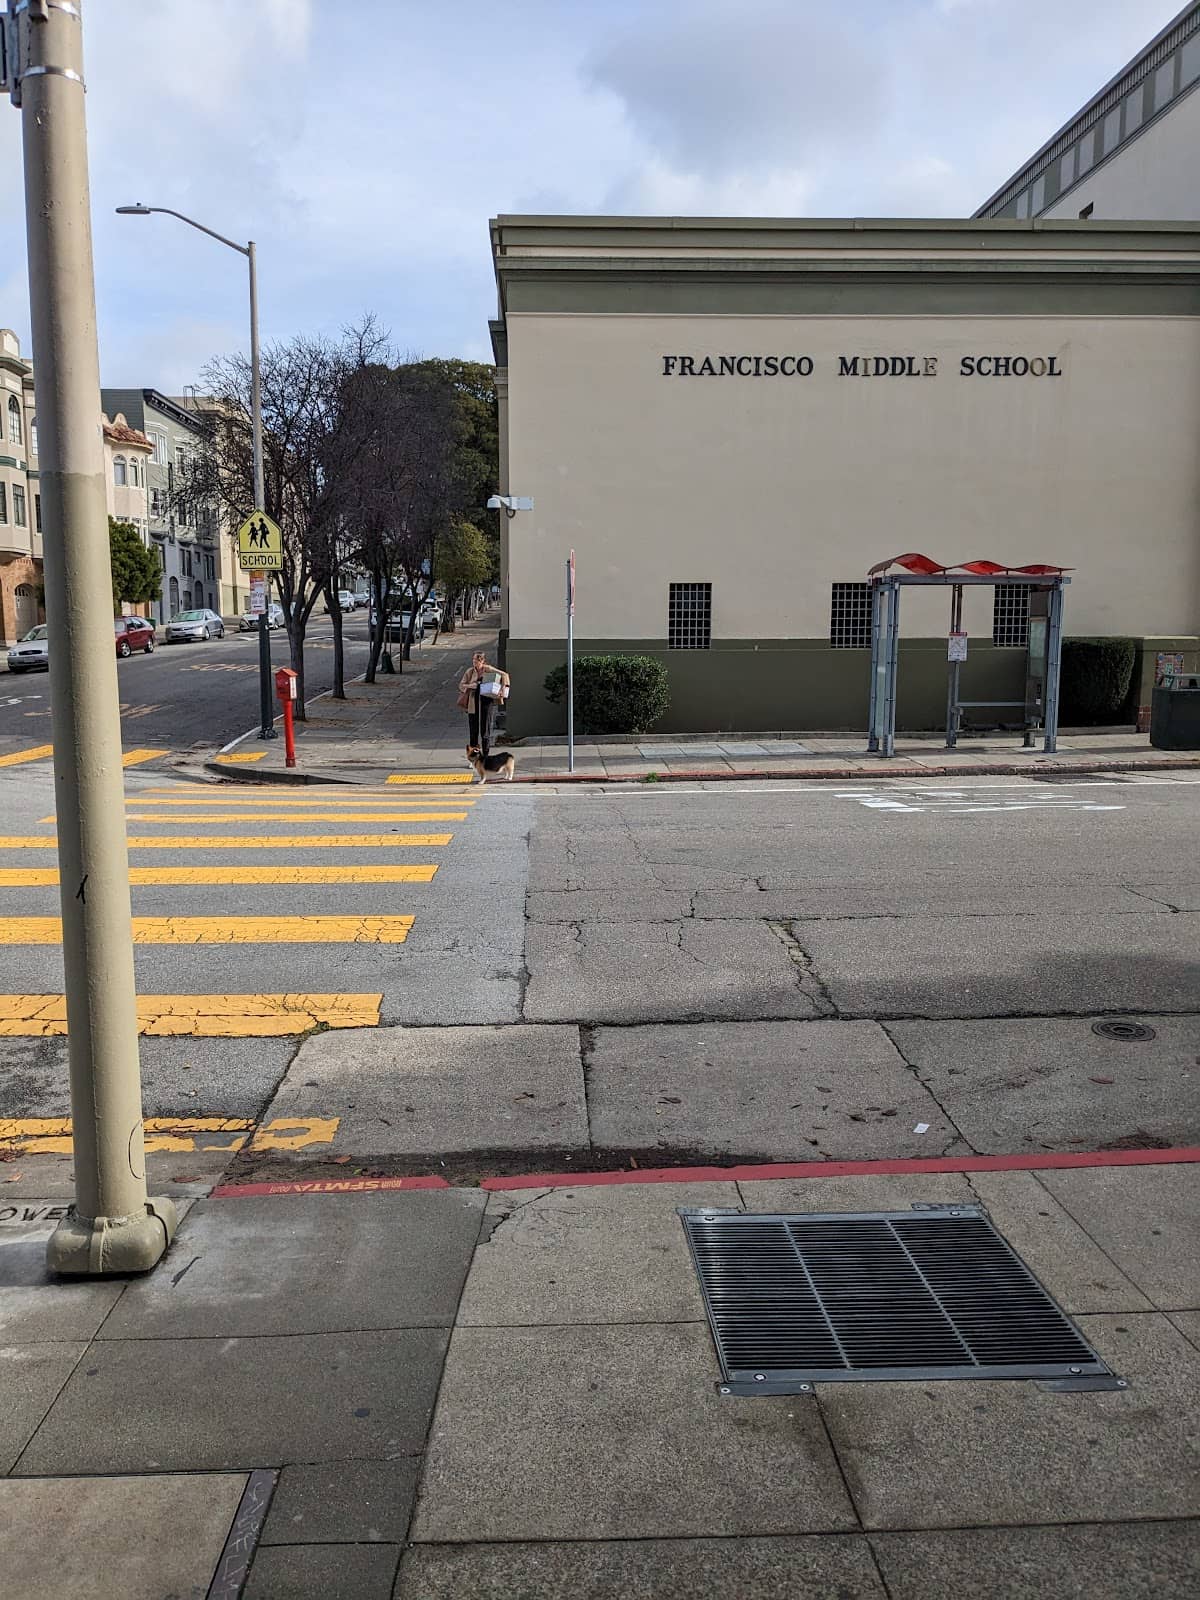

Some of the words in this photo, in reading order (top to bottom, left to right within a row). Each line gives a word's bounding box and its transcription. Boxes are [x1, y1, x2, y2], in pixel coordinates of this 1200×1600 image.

[661, 355, 814, 377] FRANCISCO
[837, 355, 938, 377] MIDDLE
[959, 355, 1063, 377] SCHOOL
[242, 555, 280, 566] SCHOOL
[293, 1180, 380, 1192] SFMTA
